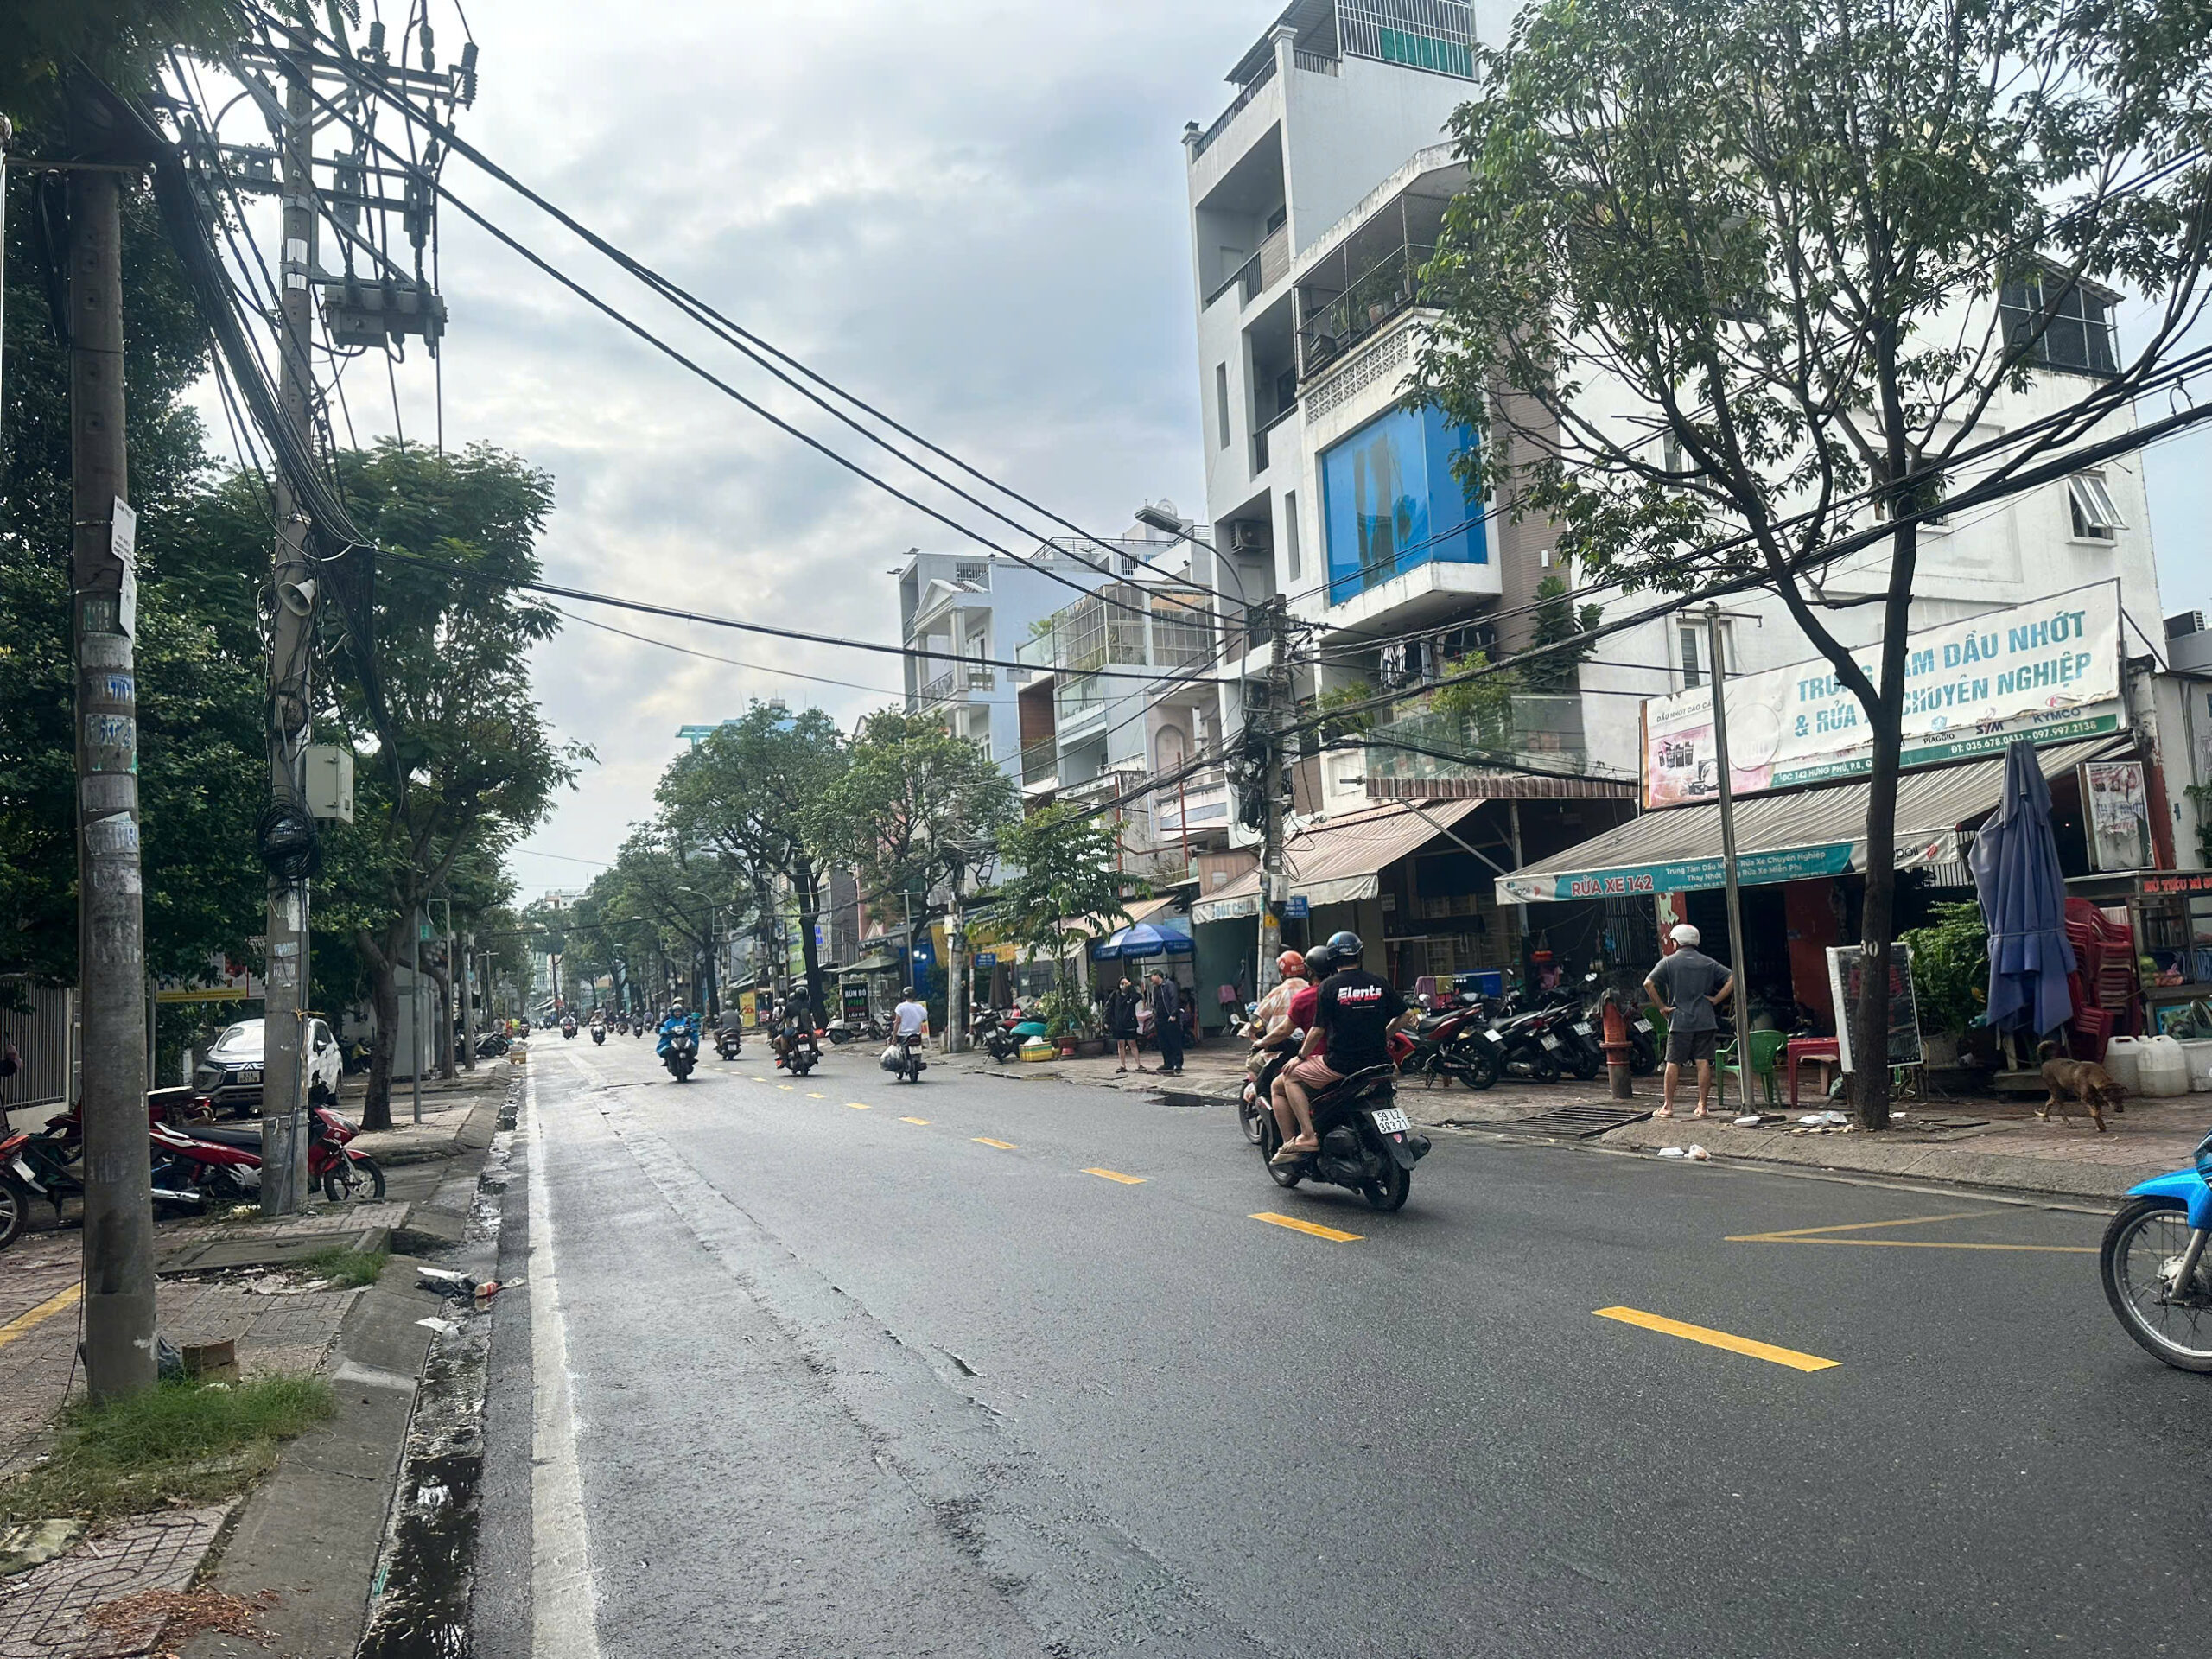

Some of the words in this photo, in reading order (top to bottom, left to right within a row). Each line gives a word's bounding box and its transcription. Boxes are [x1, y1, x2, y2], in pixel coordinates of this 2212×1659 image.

[1943, 630, 1998, 668] DẦU
[2009, 610, 2085, 653] NHỚT
[1795, 715, 1809, 737] &
[1816, 700, 1857, 733] RỬA
[1998, 652, 2092, 696] NGHIỆP
[1688, 704, 1700, 714] CAO
[2033, 707, 2081, 723] KYMCO
[1976, 721, 2004, 734] SYM
[1923, 734, 1955, 744] PIAGGIO
[1950, 745, 1964, 754] ĐT:
[2032, 721, 2097, 740] 097.997.2138
[1666, 867, 1685, 875] Trung
[1686, 865, 1701, 874] Tâm
[1756, 857, 1765, 867] Xe
[1797, 850, 1826, 862] Nghiệp
[1758, 866, 1770, 874] Xe
[1571, 875, 1602, 897] RỬA
[1605, 877, 1624, 894] XE
[1627, 874, 1654, 892] 142
[1861, 939, 1878, 957] 30
